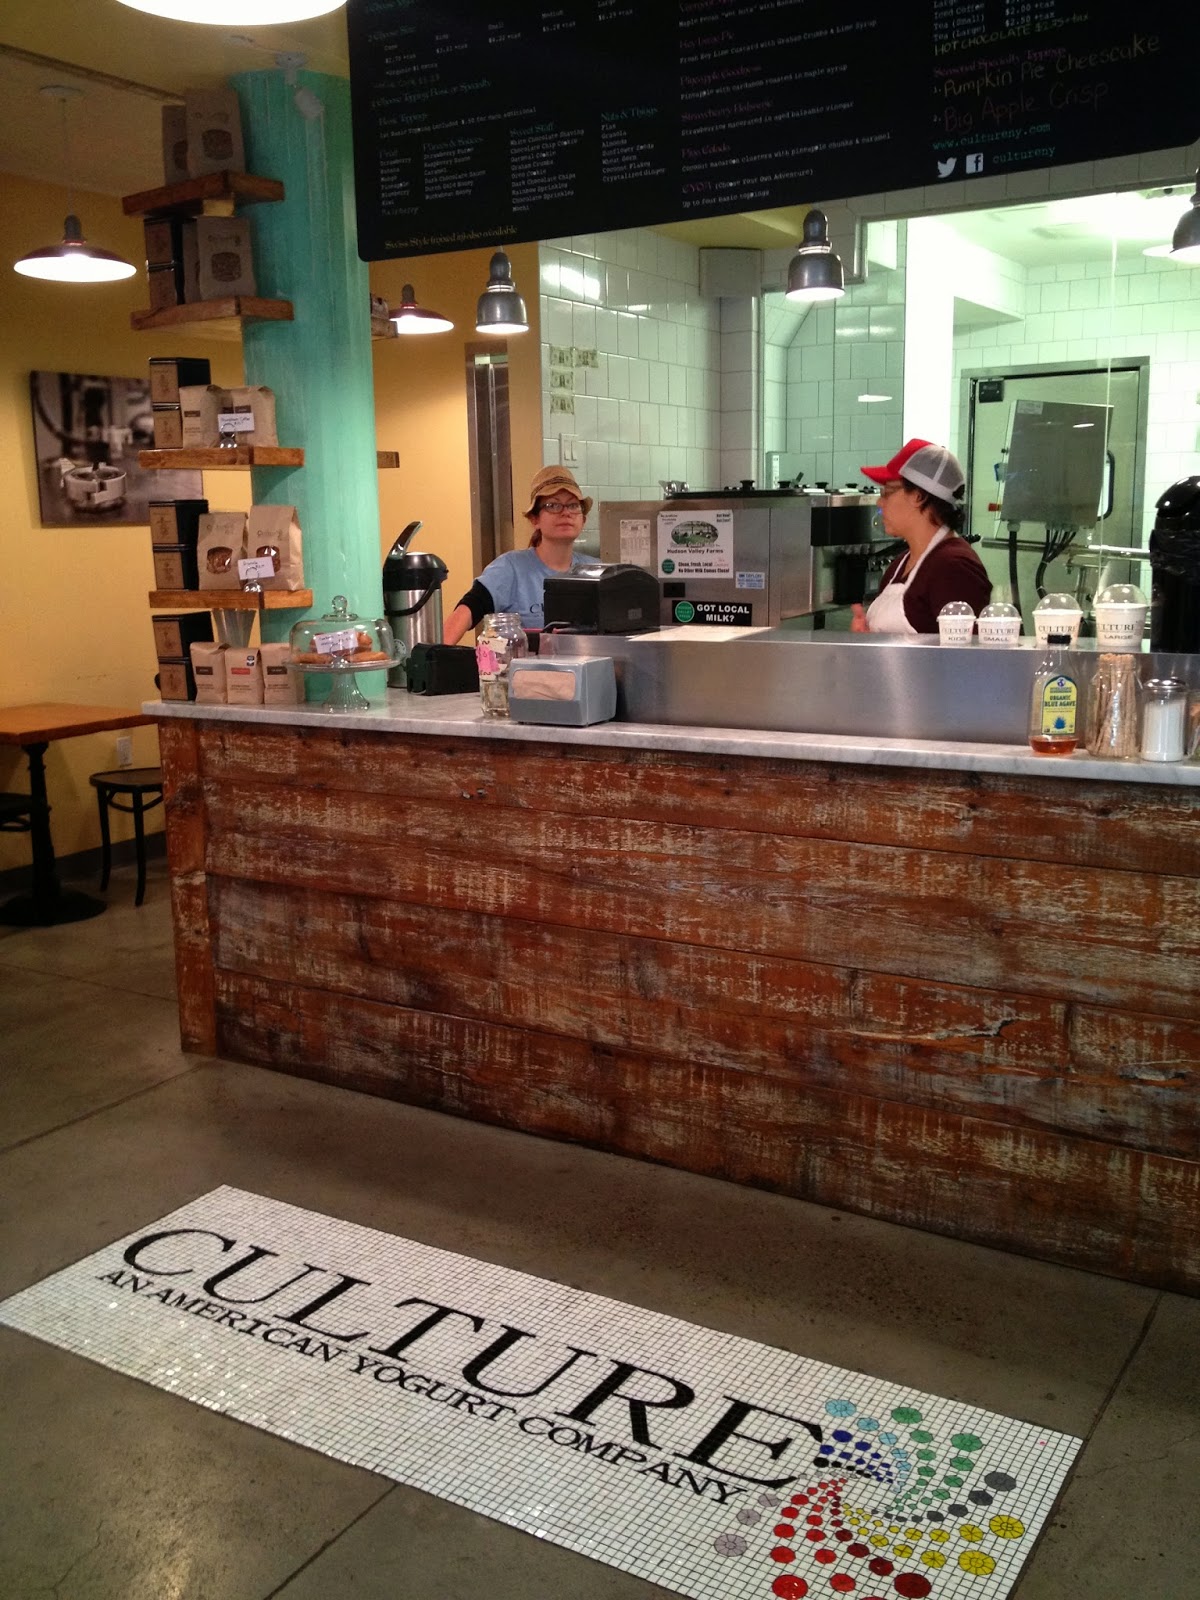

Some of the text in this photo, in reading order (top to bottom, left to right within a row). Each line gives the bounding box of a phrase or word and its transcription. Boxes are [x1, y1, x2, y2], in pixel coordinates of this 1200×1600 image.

[934, 22, 948, 30] Tea
[952, 14, 984, 28] (Small)
[1005, 4, 1032, 16] $2.00
[956, 3, 984, 15] Coffee
[934, 33, 948, 42] Tea
[952, 25, 986, 40] (Large)
[1005, 15, 1031, 28] $2.50
[713, 48, 728, 58] Lime
[760, 38, 776, 48] with
[777, 34, 802, 44] Graham
[803, 29, 828, 40] Crumbs
[836, 24, 853, 33] Lime
[856, 19, 877, 30] Syrup
[935, 24, 1032, 56] HOT CHOCOLATE
[943, 70, 1012, 98] Pumpkin
[1022, 62, 1046, 82] Pie
[1056, 32, 1160, 74] Cheesecake
[680, 88, 713, 100] Pineapple
[715, 86, 730, 94] with
[766, 74, 793, 85] roasted
[804, 68, 825, 78] maple
[826, 64, 848, 74] syrup
[728, 116, 762, 128] macerated
[774, 111, 790, 122] aged
[792, 106, 824, 117] balsamic
[826, 101, 854, 112] vinegar
[944, 106, 974, 134] Big
[982, 92, 1040, 125] Apple
[1050, 81, 1109, 112] Crisp
[528, 132, 558, 144] Chocolate
[601, 130, 626, 140] Granola
[602, 139, 628, 148] Almonds
[932, 122, 1051, 151] www.cultureny.com
[510, 144, 540, 154] Chocolate
[602, 146, 634, 157] Sunflower
[774, 149, 790, 158] with
[861, 132, 890, 144] caramel
[992, 146, 1056, 164] cultureny
[527, 175, 558, 186] Chocolate
[742, 176, 758, 184] Your
[760, 174, 772, 182] Own
[774, 168, 814, 180] Adventure)
[512, 194, 542, 204] Chocolate
[682, 200, 690, 208] Up
[692, 198, 700, 206] to
[702, 196, 716, 205] four
[483, 225, 518, 238] available
[696, 604, 750, 614] GOT LOCAL
[706, 614, 735, 622] MILK?
[123, 1228, 823, 1489] CULTURE
[96, 1269, 748, 1506] AN AMERICAN YOGURT COMPANY
